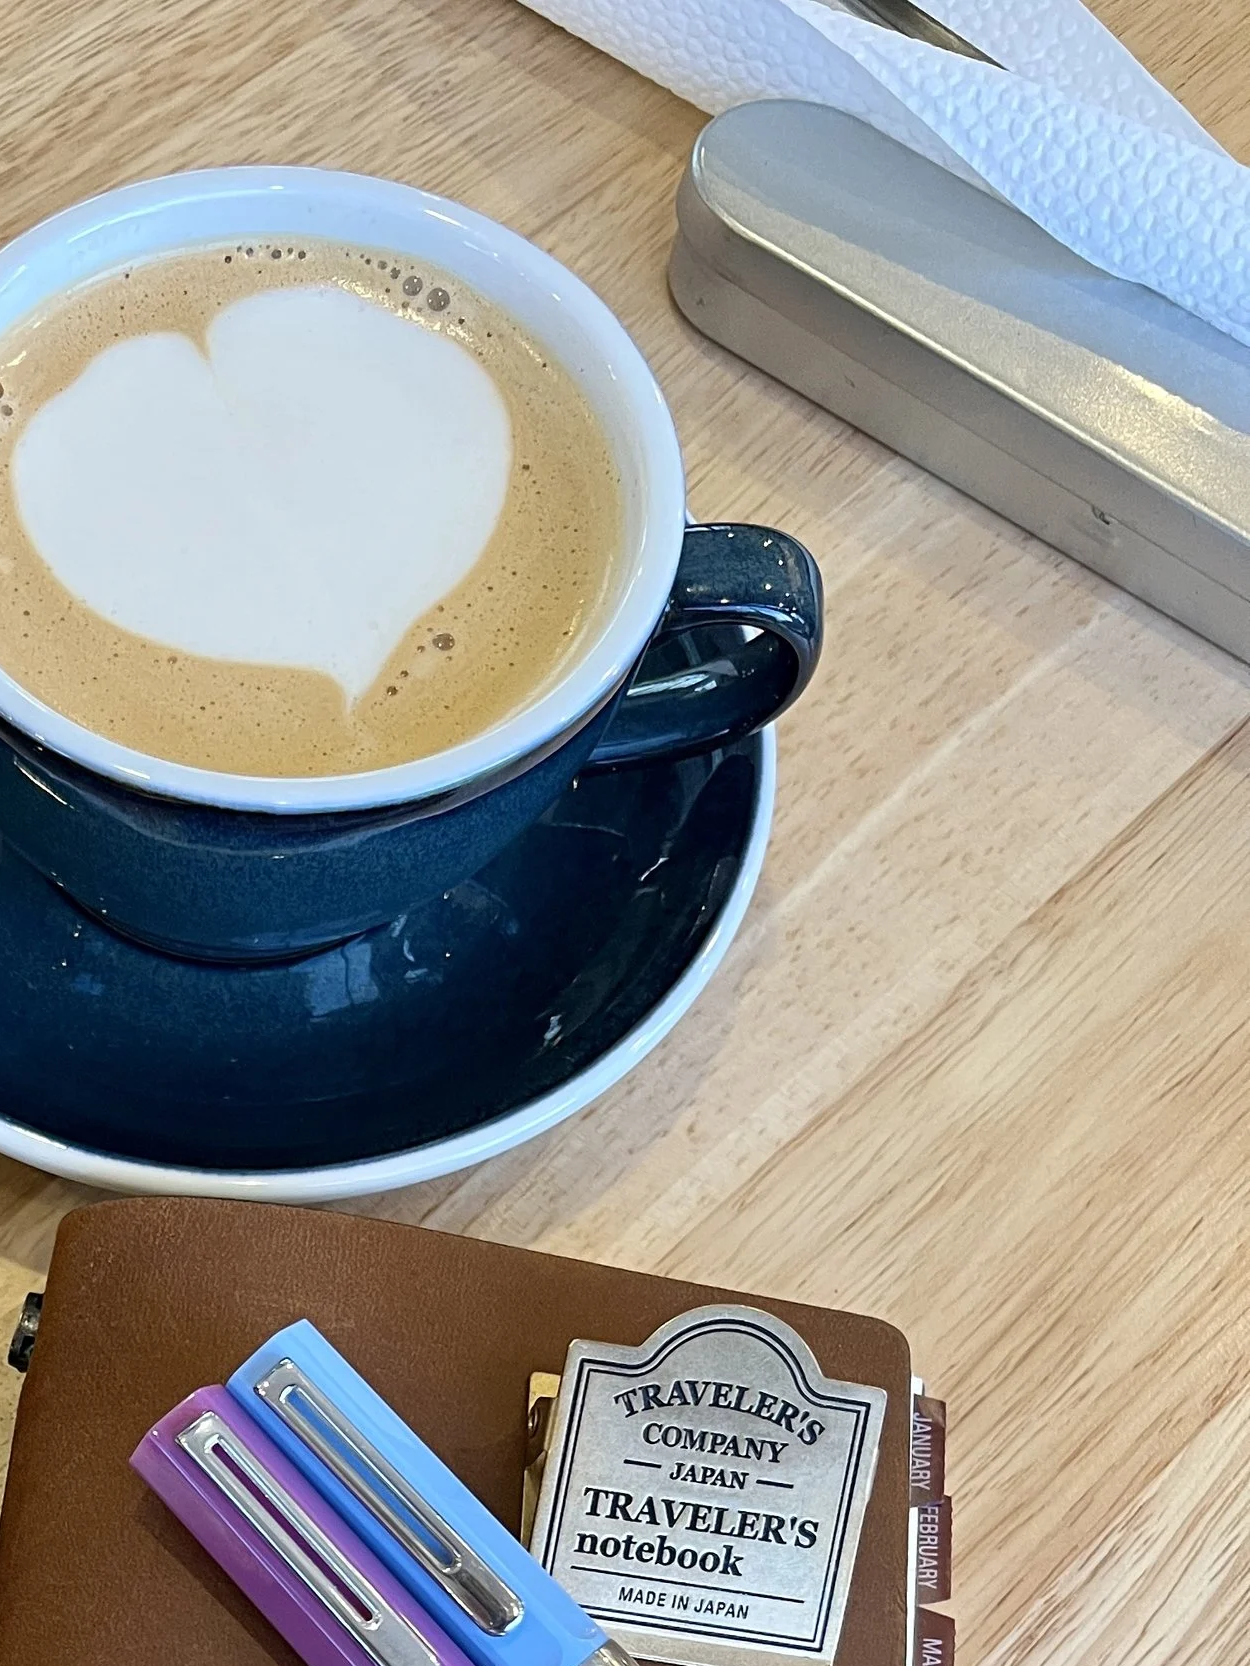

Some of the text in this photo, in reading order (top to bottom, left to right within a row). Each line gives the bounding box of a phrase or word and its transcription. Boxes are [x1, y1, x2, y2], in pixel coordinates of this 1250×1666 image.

[613, 1380, 826, 1446] TRAVELER'S
[642, 1422, 789, 1464] COMPANY
[911, 1411, 932, 1491] JANUARY
[669, 1463, 749, 1490] JAPAN
[583, 1487, 819, 1550] TRAVELER'S
[574, 1531, 745, 1577] notebook
[918, 1505, 939, 1590] FEBRUARY
[618, 1586, 749, 1620] MADE IN JAPAN
